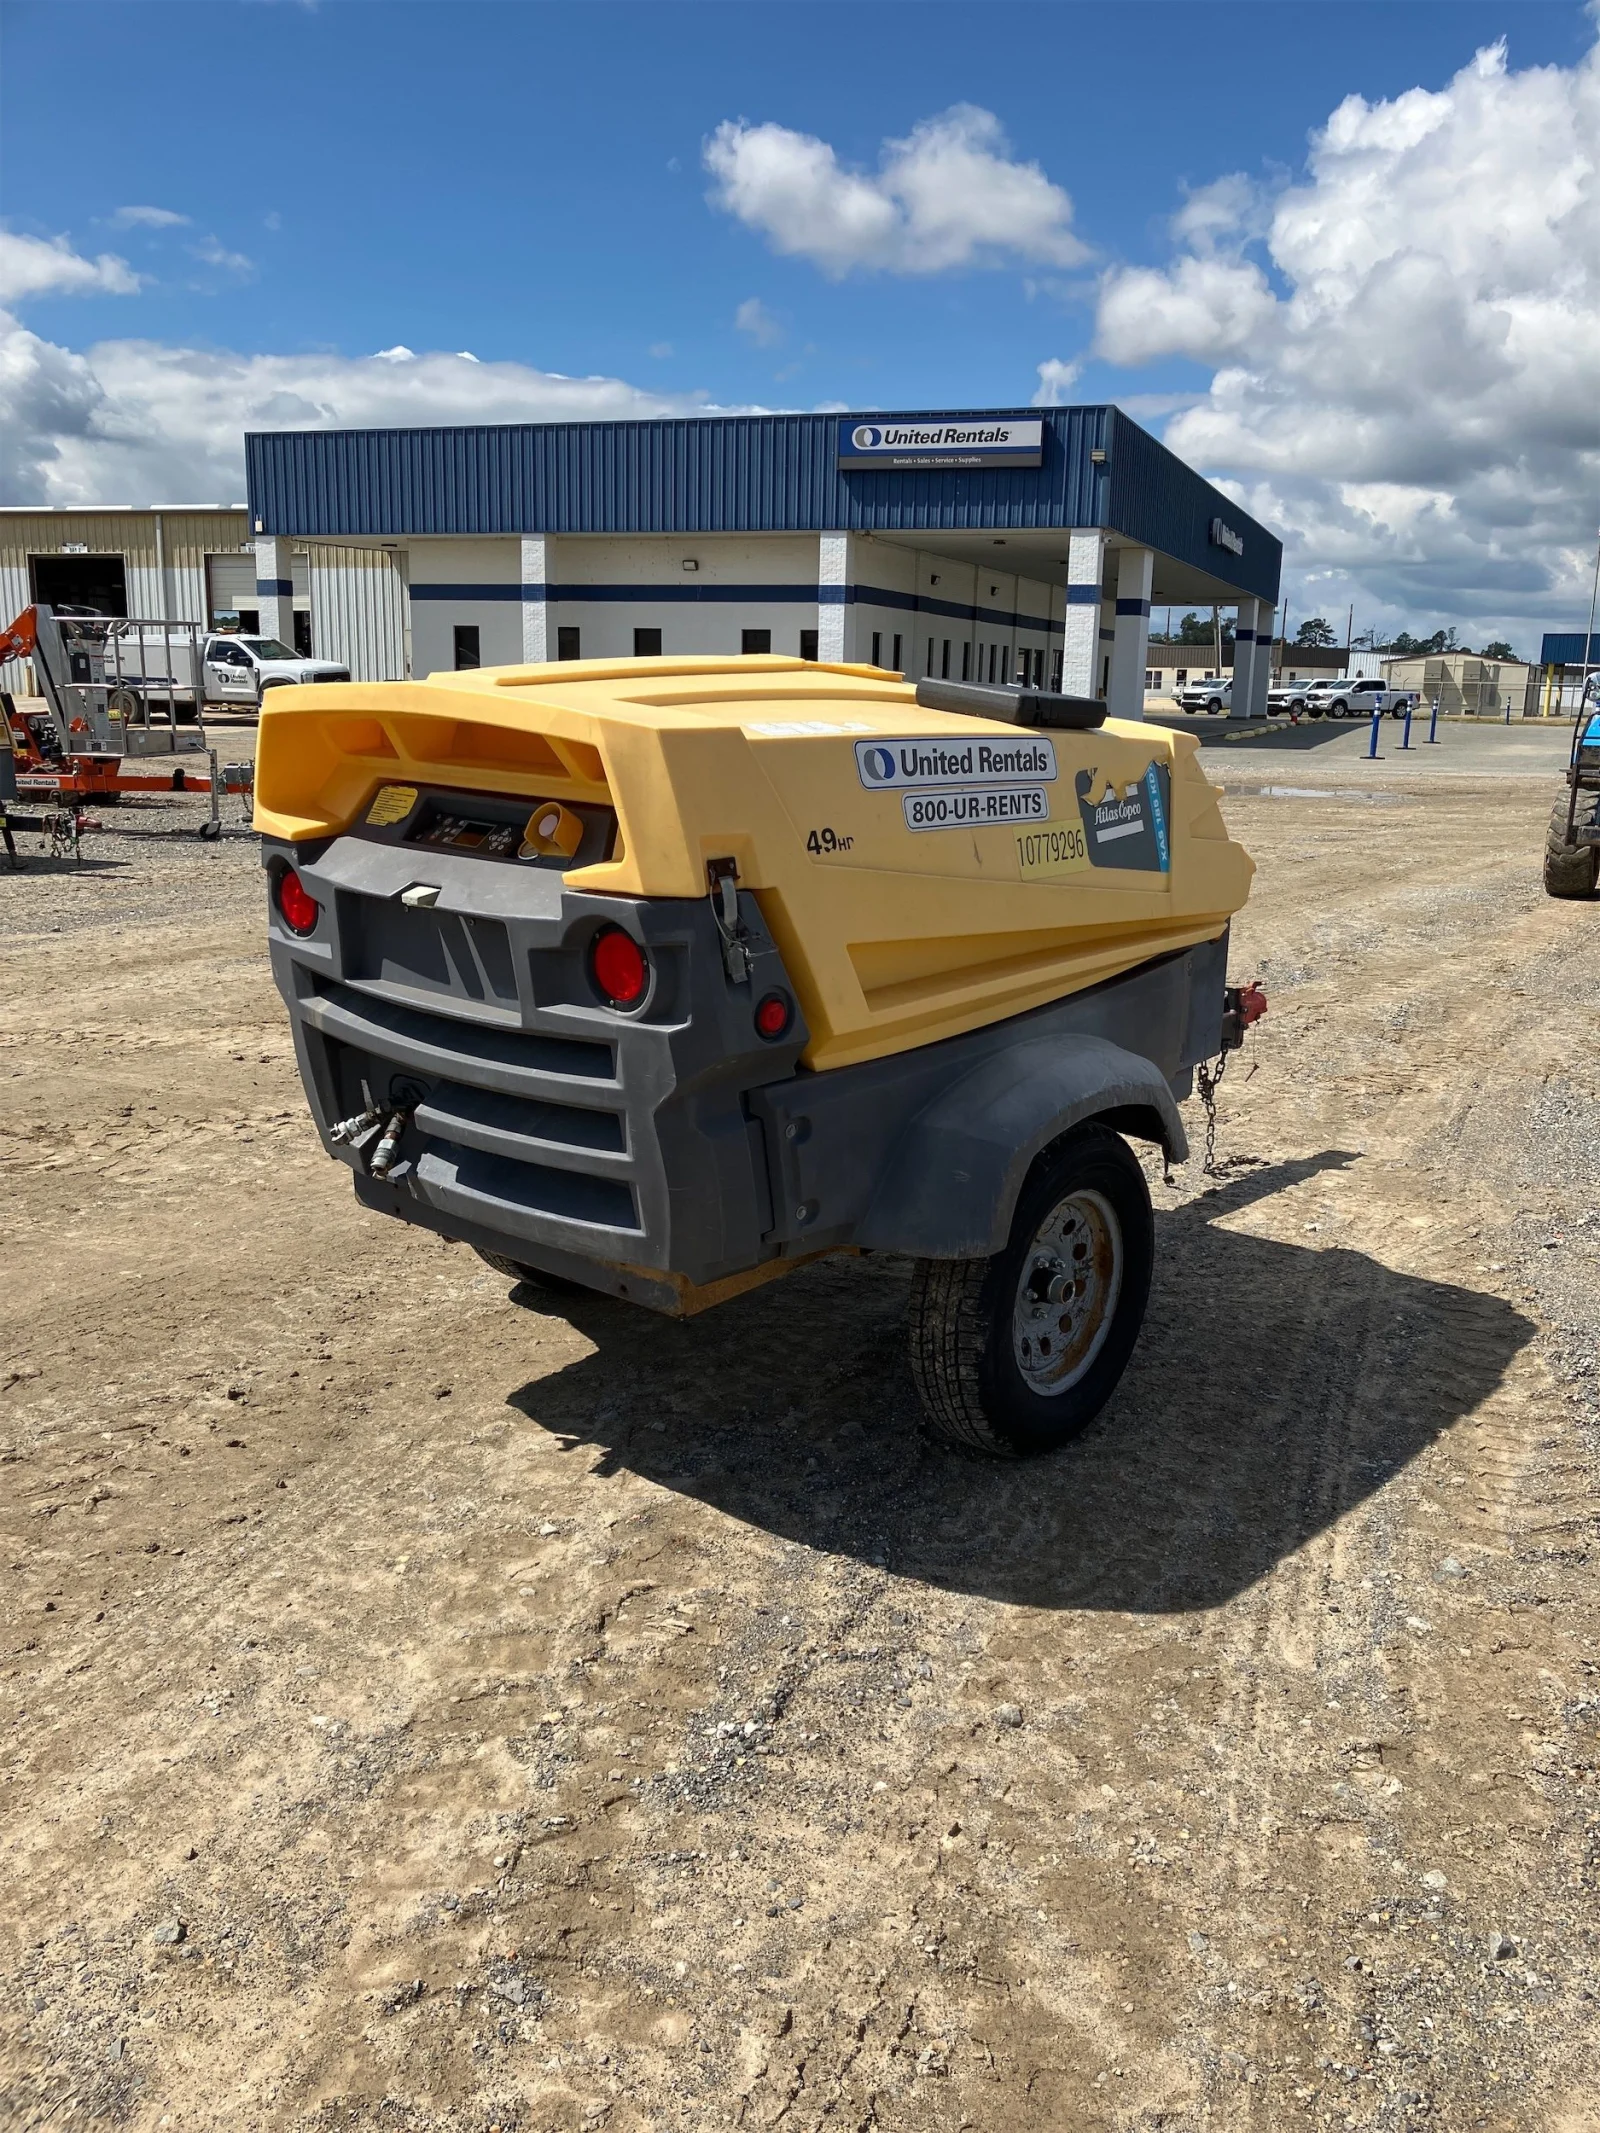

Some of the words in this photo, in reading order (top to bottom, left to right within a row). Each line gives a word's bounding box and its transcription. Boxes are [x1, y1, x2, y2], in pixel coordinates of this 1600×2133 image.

[884, 429, 943, 444] United
[944, 427, 1009, 443] Rentals
[958, 456, 981, 464] Supplies
[900, 747, 973, 777] United
[978, 746, 1048, 773] Rentals
[912, 793, 1042, 823] 800-UR-RENTS
[1016, 829, 1084, 866] 10779296
[1158, 830, 1167, 860] XAS
